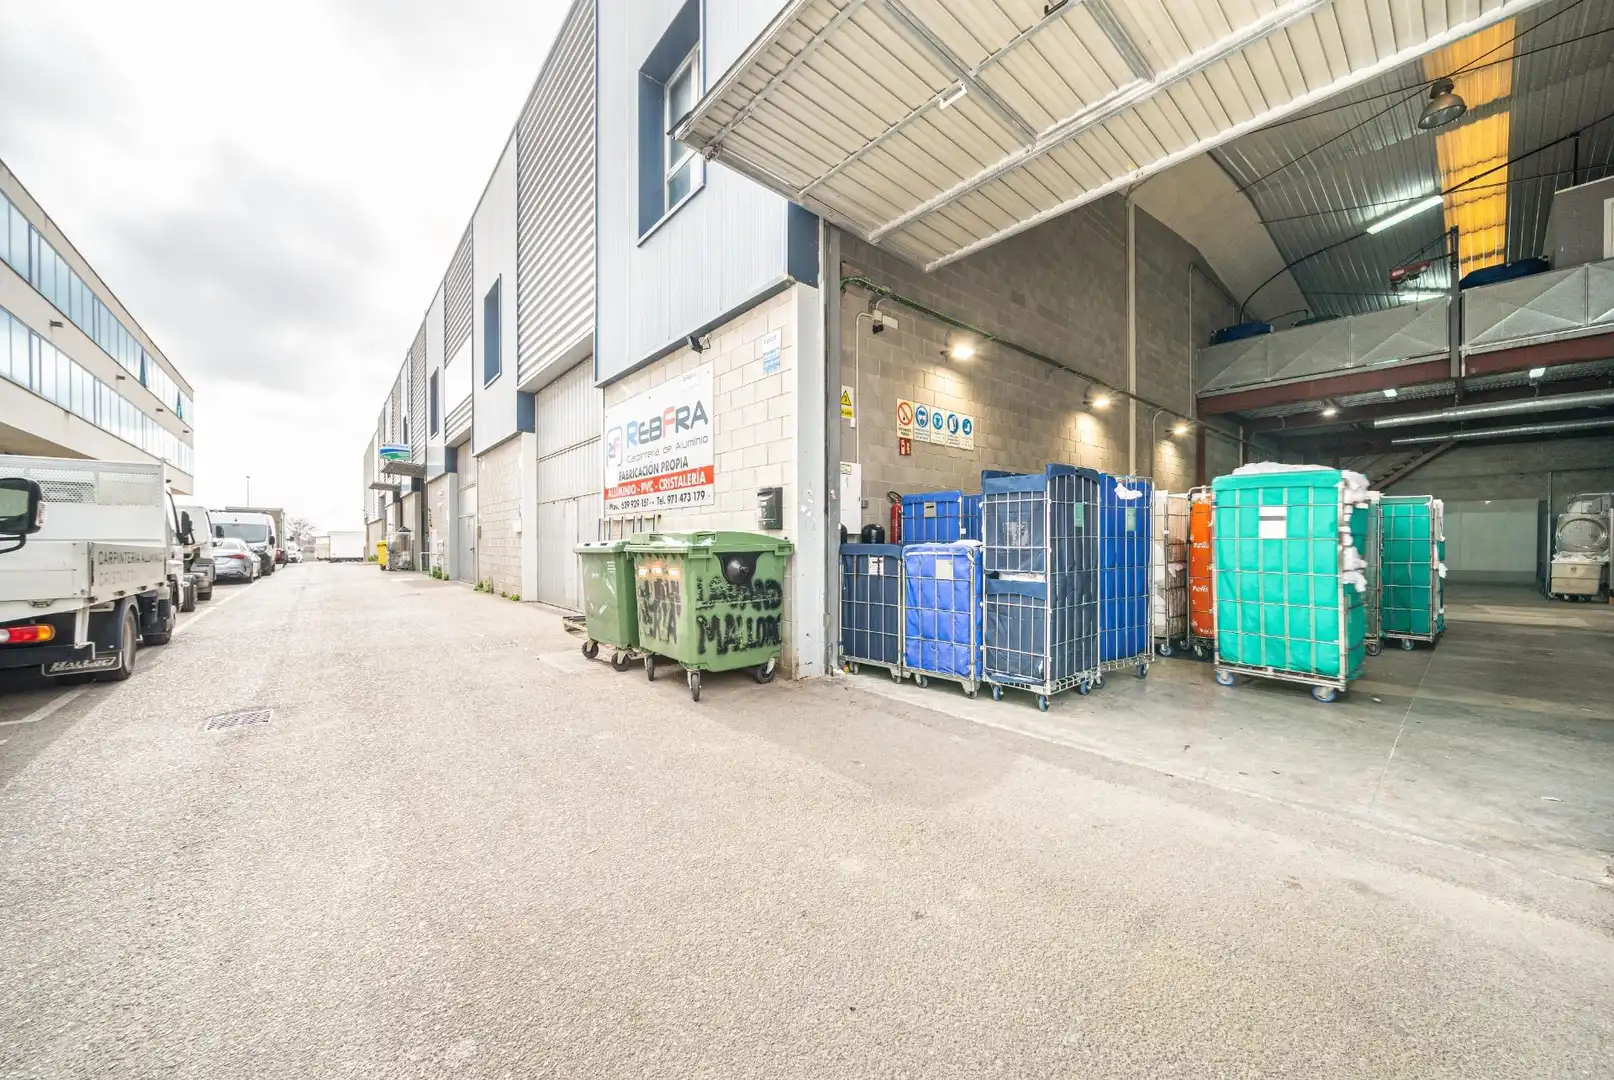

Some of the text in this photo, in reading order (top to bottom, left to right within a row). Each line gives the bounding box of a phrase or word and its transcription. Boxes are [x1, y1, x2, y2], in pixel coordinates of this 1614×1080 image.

[660, 455, 689, 473] PROPIA
[641, 479, 655, 494] PVC
[659, 467, 706, 490] CRISTALERÍA
[667, 493, 678, 504] 971
[679, 491, 692, 503] 473
[693, 489, 706, 501] 179
